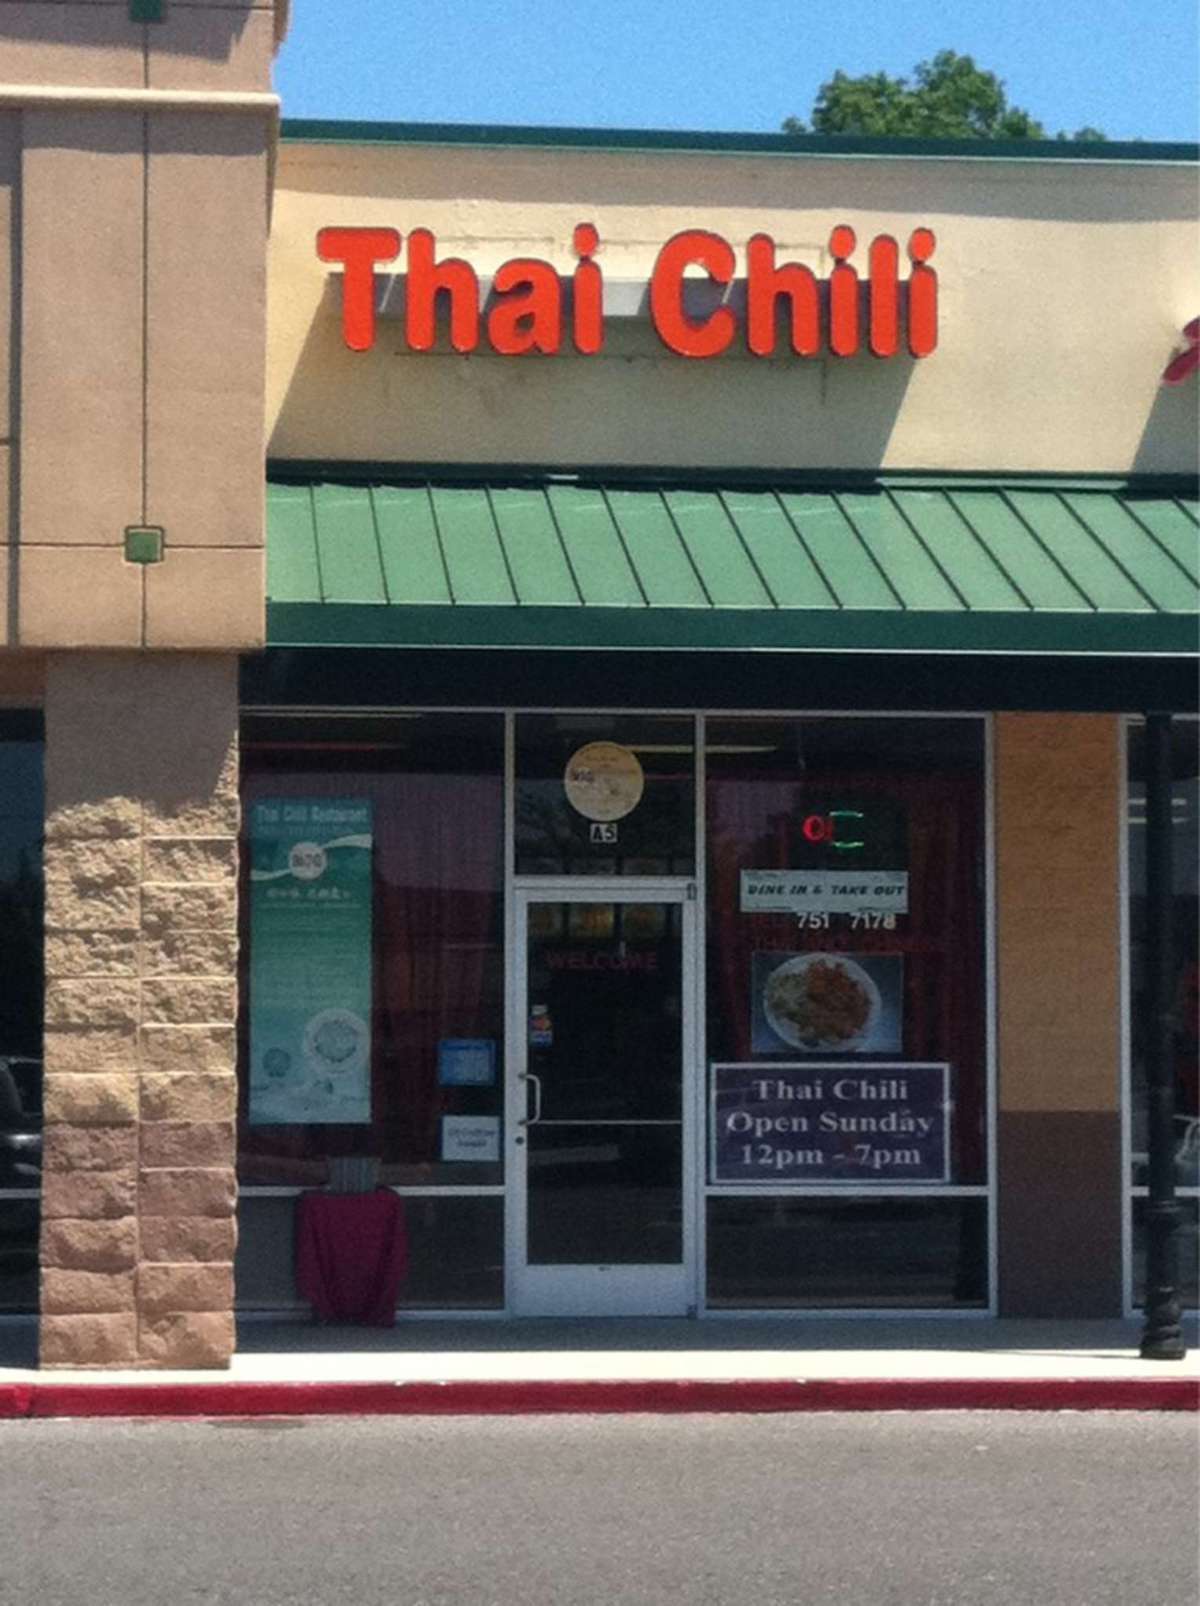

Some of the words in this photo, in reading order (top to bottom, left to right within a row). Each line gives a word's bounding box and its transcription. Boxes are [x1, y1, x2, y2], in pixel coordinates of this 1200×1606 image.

[316, 222, 605, 354] Thai
[650, 224, 939, 359] Chili
[591, 823, 617, 841] A5
[747, 884, 785, 896] DINE
[789, 884, 808, 896] IN
[831, 884, 868, 896] TAKE
[873, 884, 905, 896] OUT
[797, 911, 830, 929] 751
[851, 911, 897, 930] 7178
[752, 1079, 824, 1101] Thai
[832, 1079, 909, 1101] Chili
[727, 1111, 809, 1138] Open
[819, 1111, 935, 1138] Sunday
[742, 1144, 824, 1170] 12pm
[854, 1144, 921, 1170] 7pm
